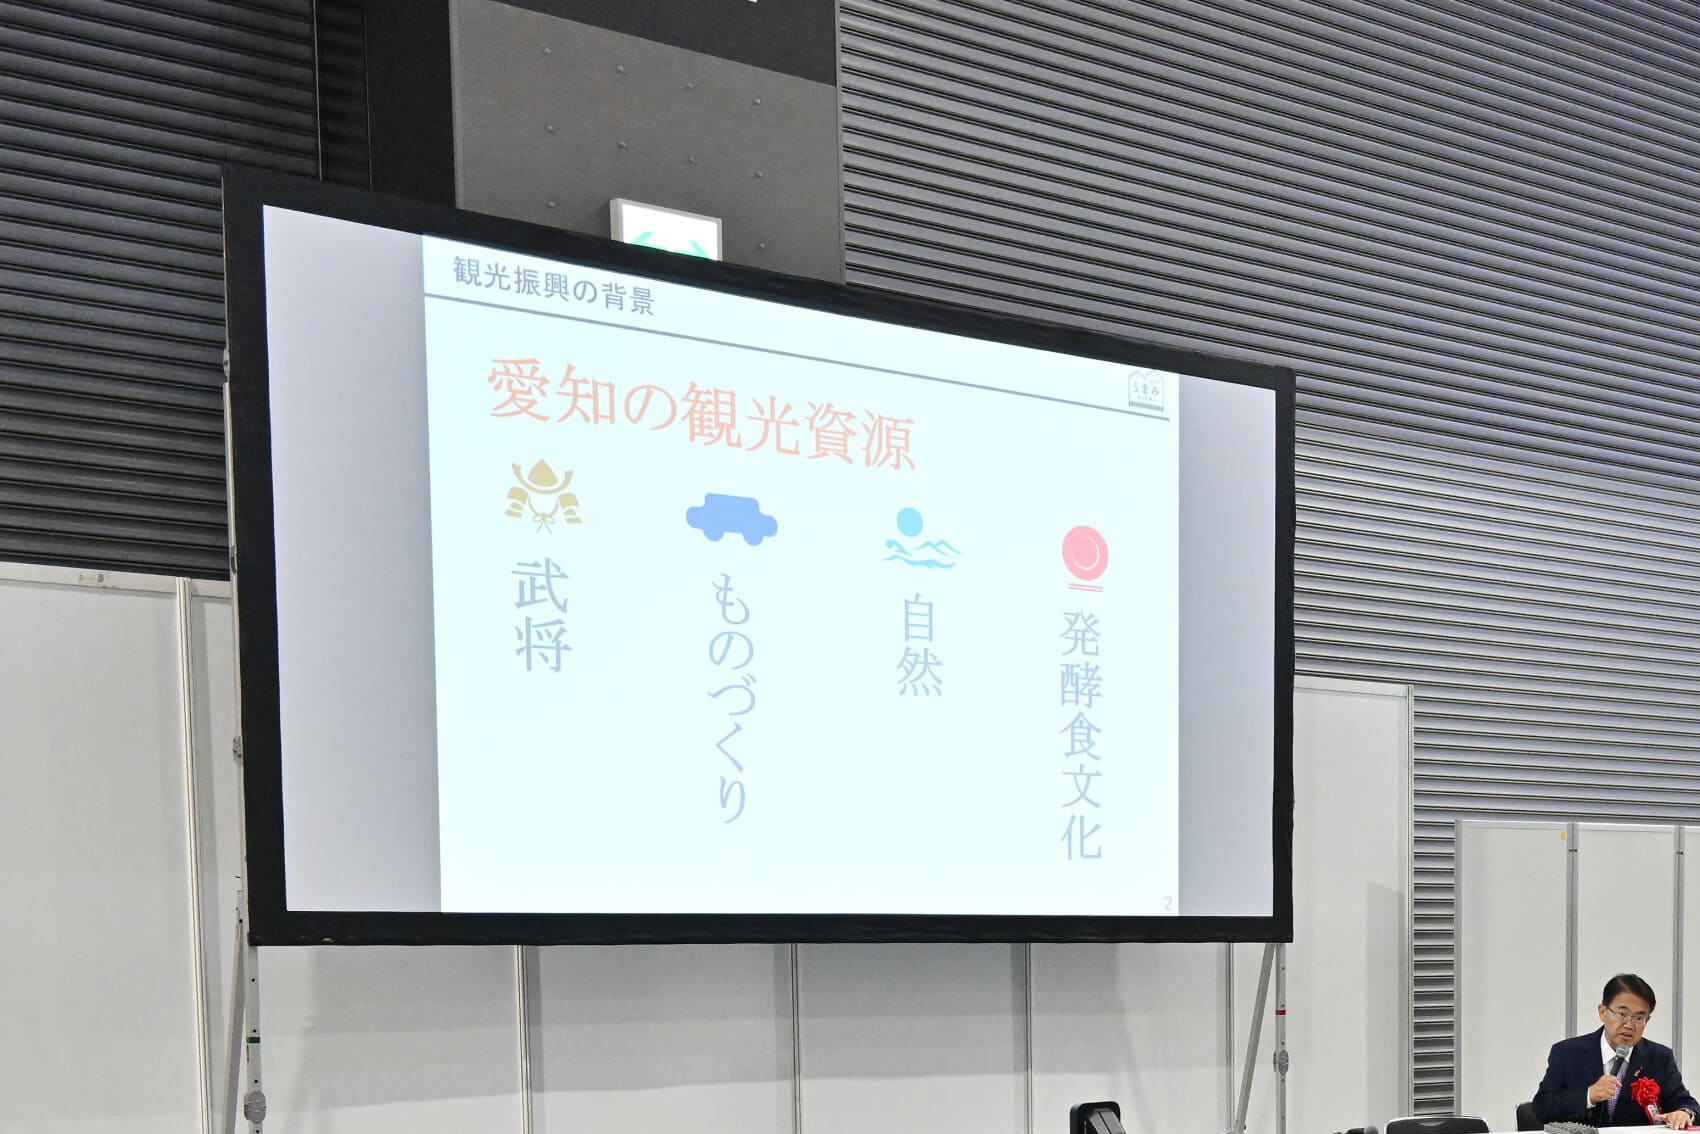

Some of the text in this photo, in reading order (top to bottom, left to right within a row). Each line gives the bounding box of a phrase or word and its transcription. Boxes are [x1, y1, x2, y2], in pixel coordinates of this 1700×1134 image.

[453, 256, 655, 316] 観光振興の背景
[487, 356, 917, 472] 愛知の観光資源
[511, 557, 572, 673] 武将
[896, 593, 943, 697] 自然
[706, 573, 757, 824] ものづくり
[1059, 610, 1103, 861] 発酵食文化
[1163, 895, 1173, 910] 2
